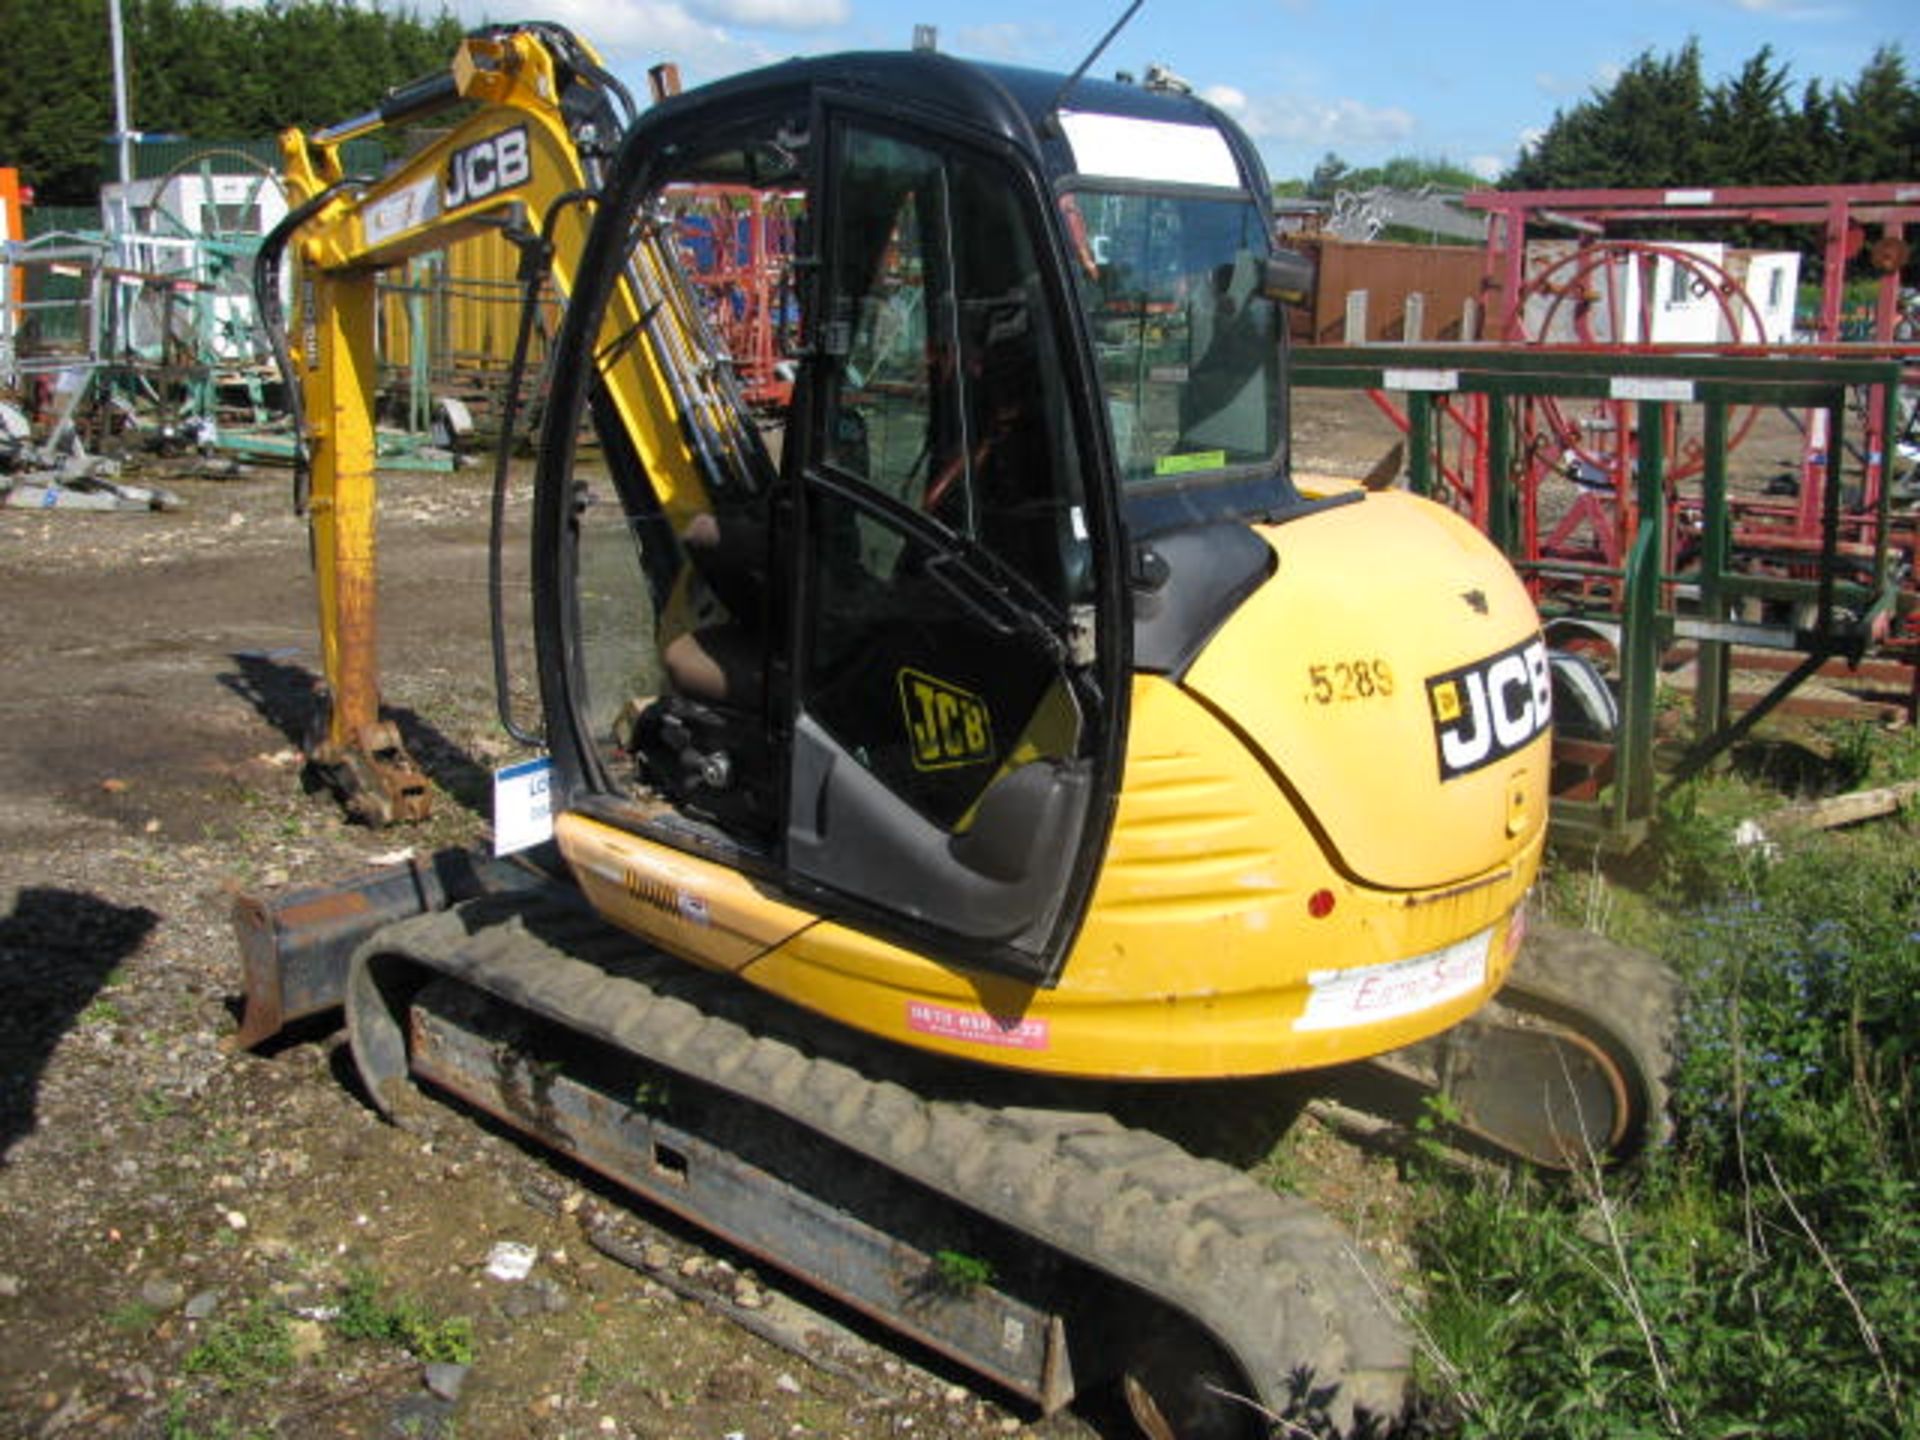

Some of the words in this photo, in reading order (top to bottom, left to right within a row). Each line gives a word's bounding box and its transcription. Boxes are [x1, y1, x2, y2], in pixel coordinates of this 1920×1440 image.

[444, 129, 529, 209] JCB
[914, 682, 985, 760] JCB
[1441, 640, 1551, 769] JCB
